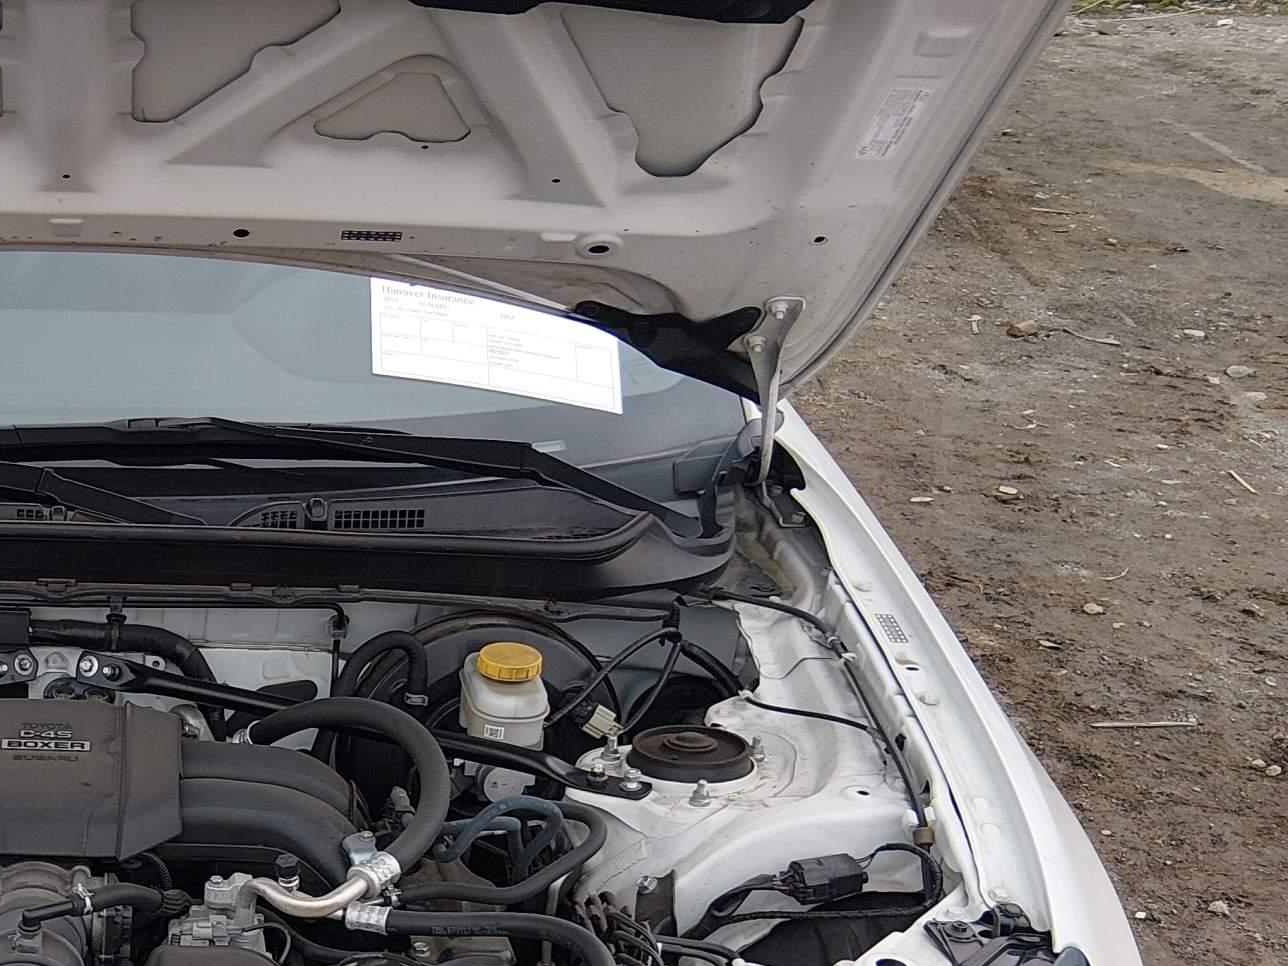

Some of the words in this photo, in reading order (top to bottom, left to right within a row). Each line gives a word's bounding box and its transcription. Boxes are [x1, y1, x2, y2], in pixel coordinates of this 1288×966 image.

[382, 285, 424, 298] Hanover
[427, 291, 475, 305] Insurance
[21, 722, 72, 730] TOYOTA
[20, 729, 73, 739] D-4S
[7, 740, 86, 750] BOXER
[13, 754, 79, 762] SUBARU
